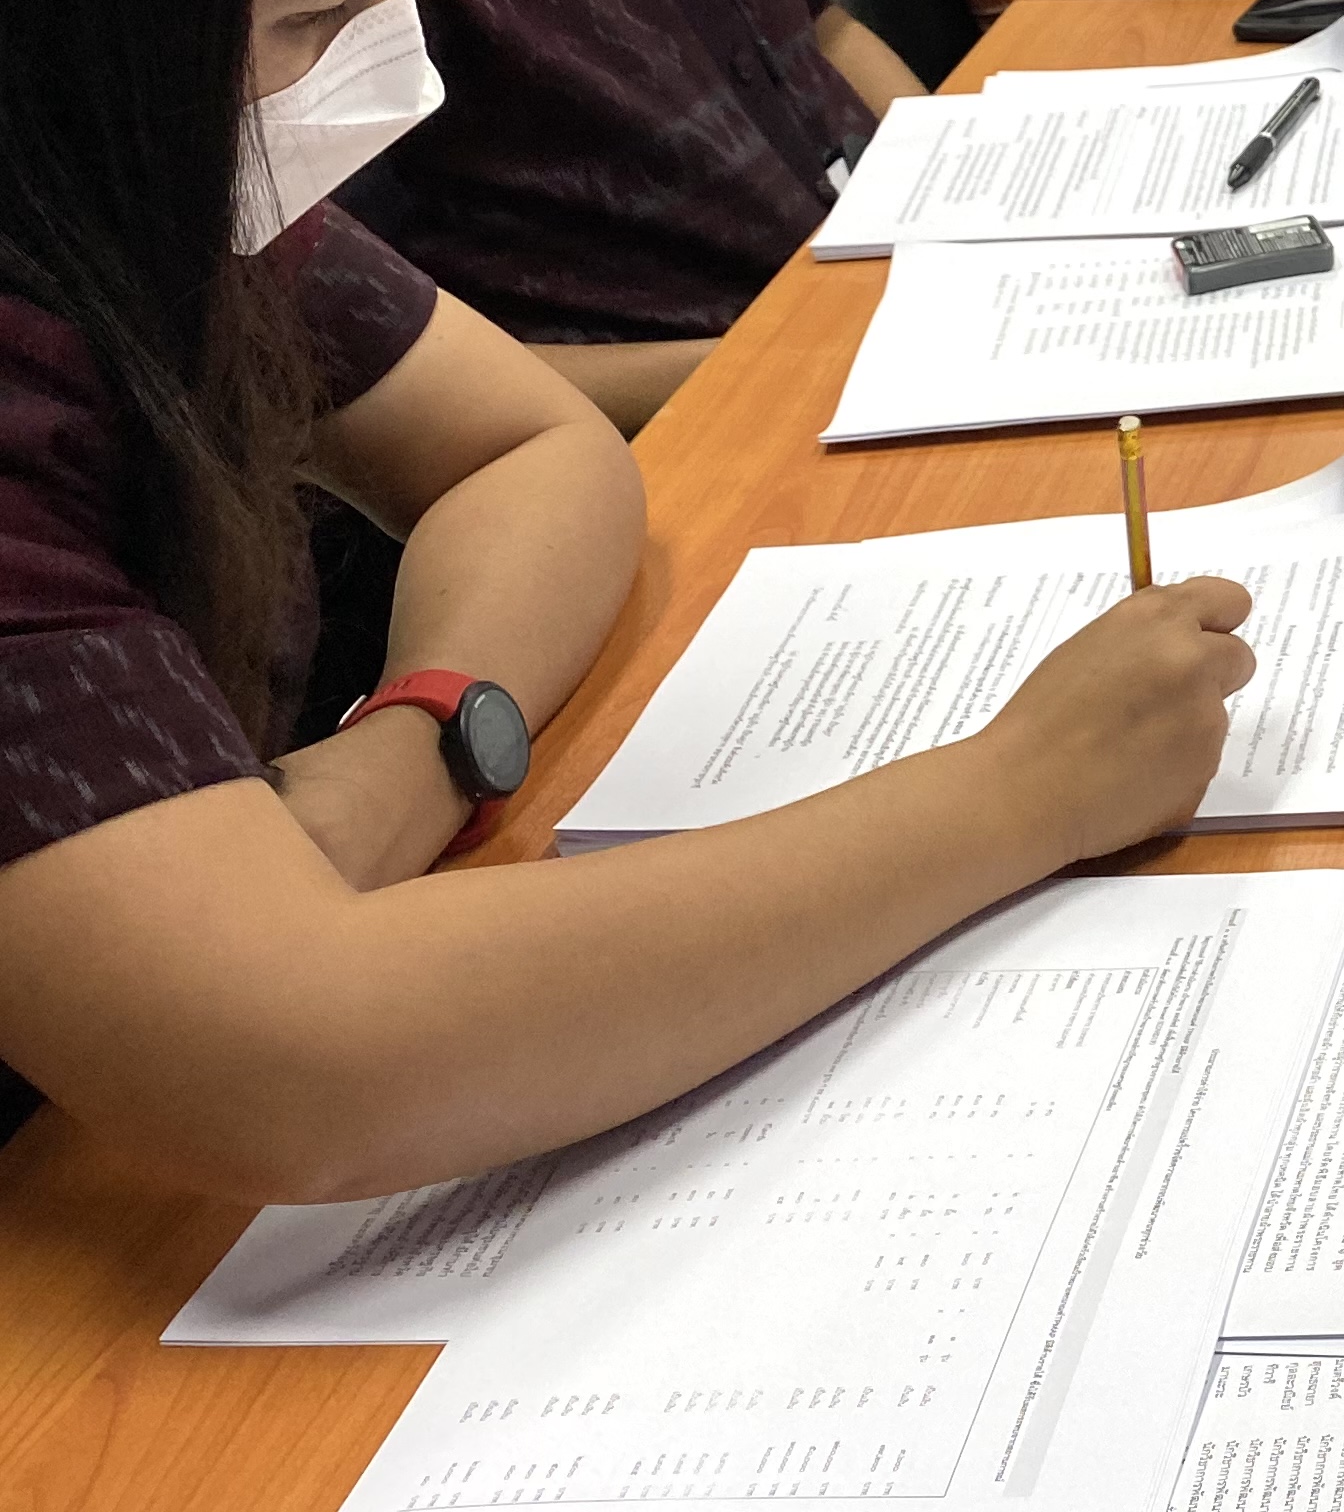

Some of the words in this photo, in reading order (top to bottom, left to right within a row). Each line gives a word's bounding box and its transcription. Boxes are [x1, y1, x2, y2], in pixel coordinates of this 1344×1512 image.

[1211, 1440, 1240, 1512] นักวิชาการพัฒน
